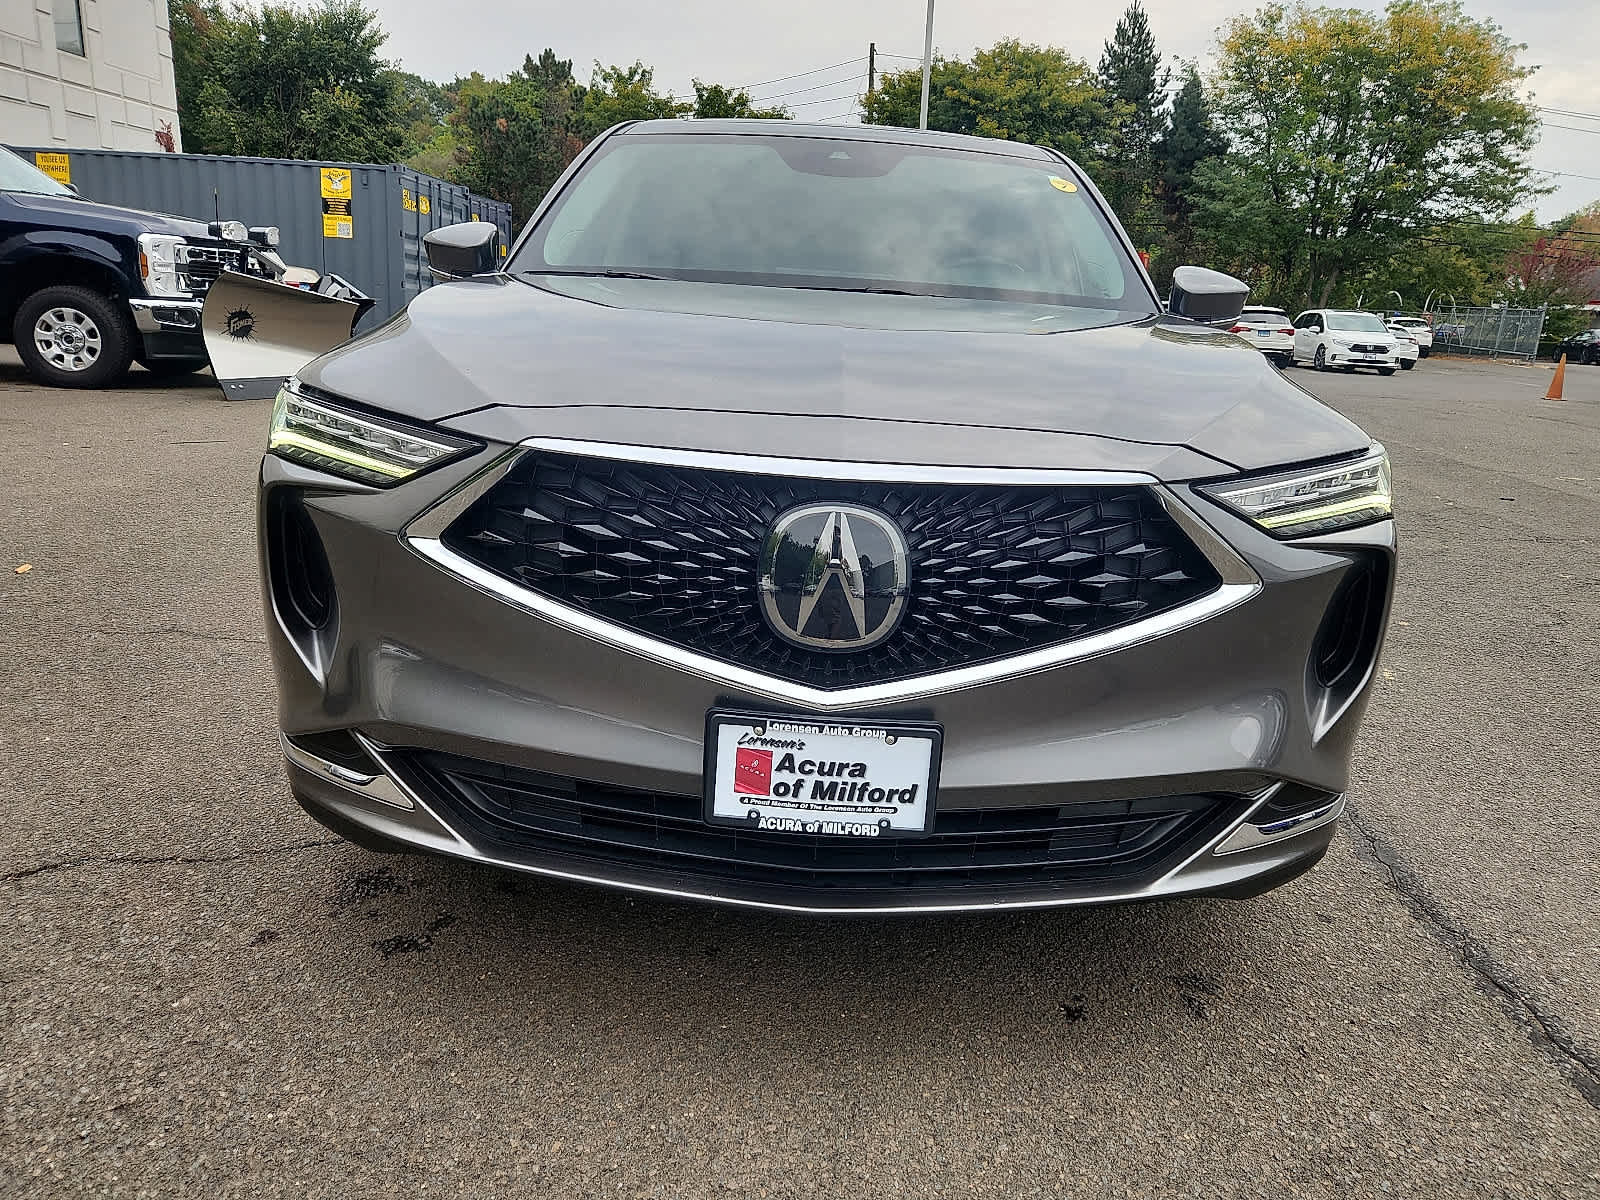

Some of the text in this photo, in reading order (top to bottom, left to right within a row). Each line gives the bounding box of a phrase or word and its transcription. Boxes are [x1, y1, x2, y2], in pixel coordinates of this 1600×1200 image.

[767, 720, 886, 739] Lorensen Auto Group
[737, 732, 806, 751] Lorensen's
[775, 752, 867, 778] Acura
[773, 778, 918, 804] of Milford
[771, 800, 798, 809] Member
[758, 817, 880, 837] ACURA of MILFORD
